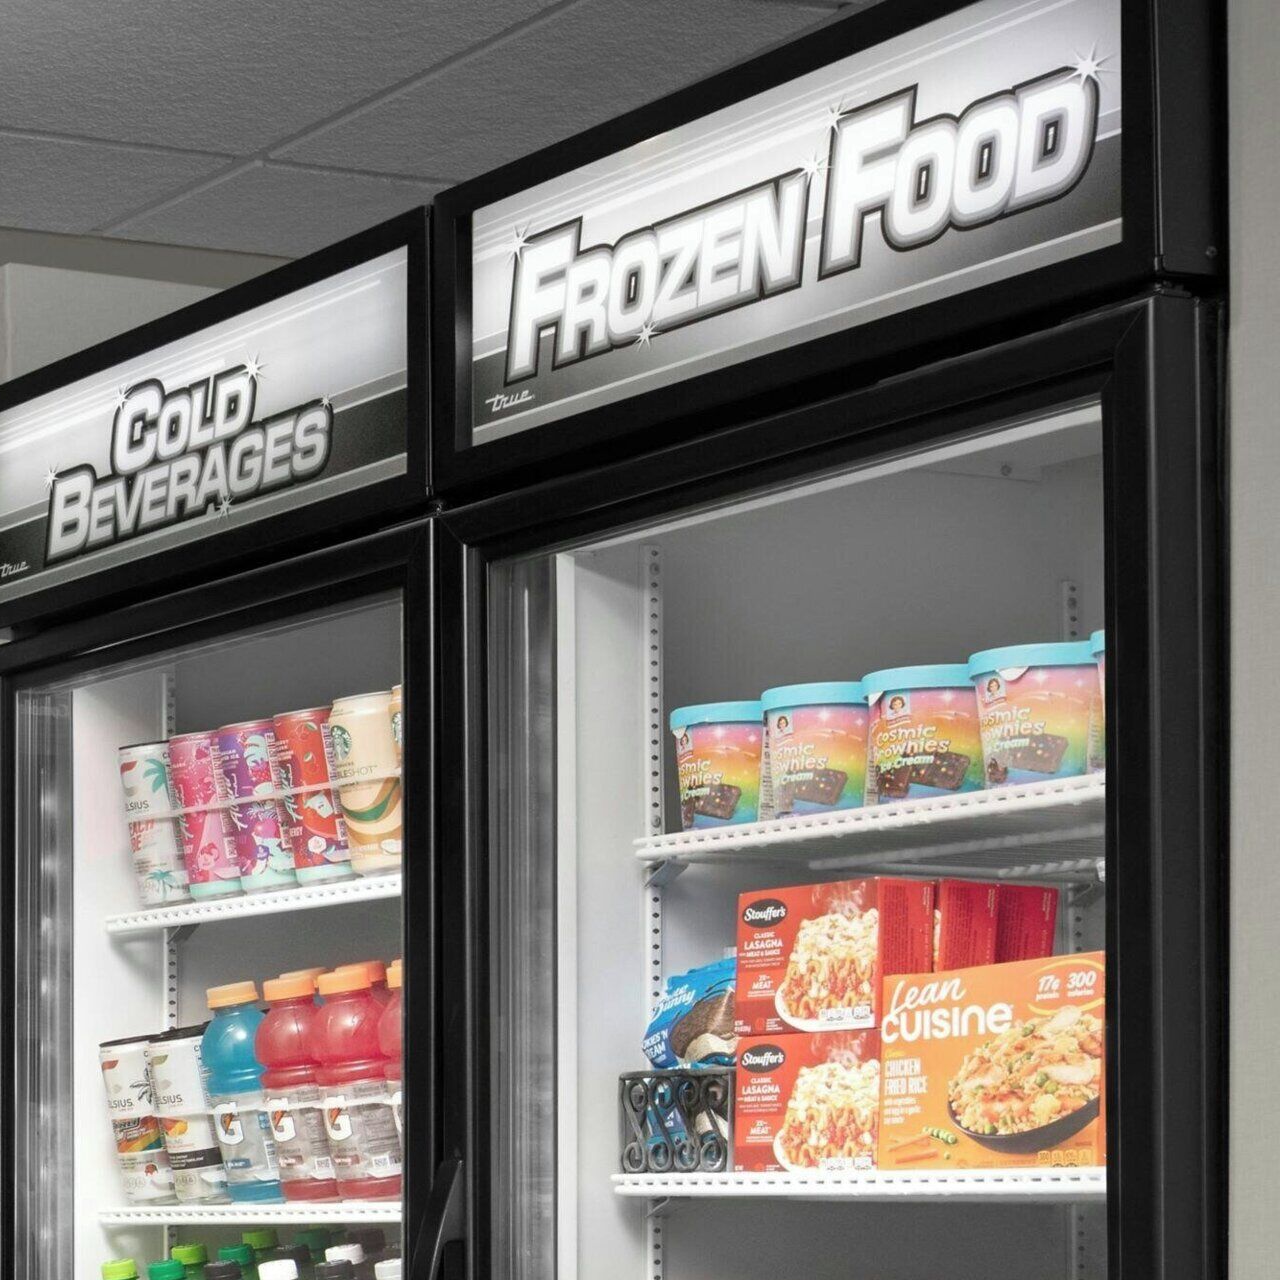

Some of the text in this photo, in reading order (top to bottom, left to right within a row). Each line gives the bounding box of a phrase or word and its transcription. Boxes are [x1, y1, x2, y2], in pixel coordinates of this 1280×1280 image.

[505, 66, 1098, 386] FROZEN FOOD
[485, 388, 534, 412] true
[112, 365, 258, 475] COLD
[47, 399, 333, 561] BEVERAGES
[877, 724, 937, 747] Cosmic
[744, 905, 787, 922] Stouffer's
[744, 938, 783, 949] LASAGNA
[1067, 970, 1096, 989] 300
[887, 977, 967, 1016] Lean
[742, 1050, 785, 1067] Stouffer's
[884, 1057, 922, 1078] CHICKEN
[742, 1084, 781, 1095] LASAGNA
[884, 1075, 928, 1094] FRIED RICE
